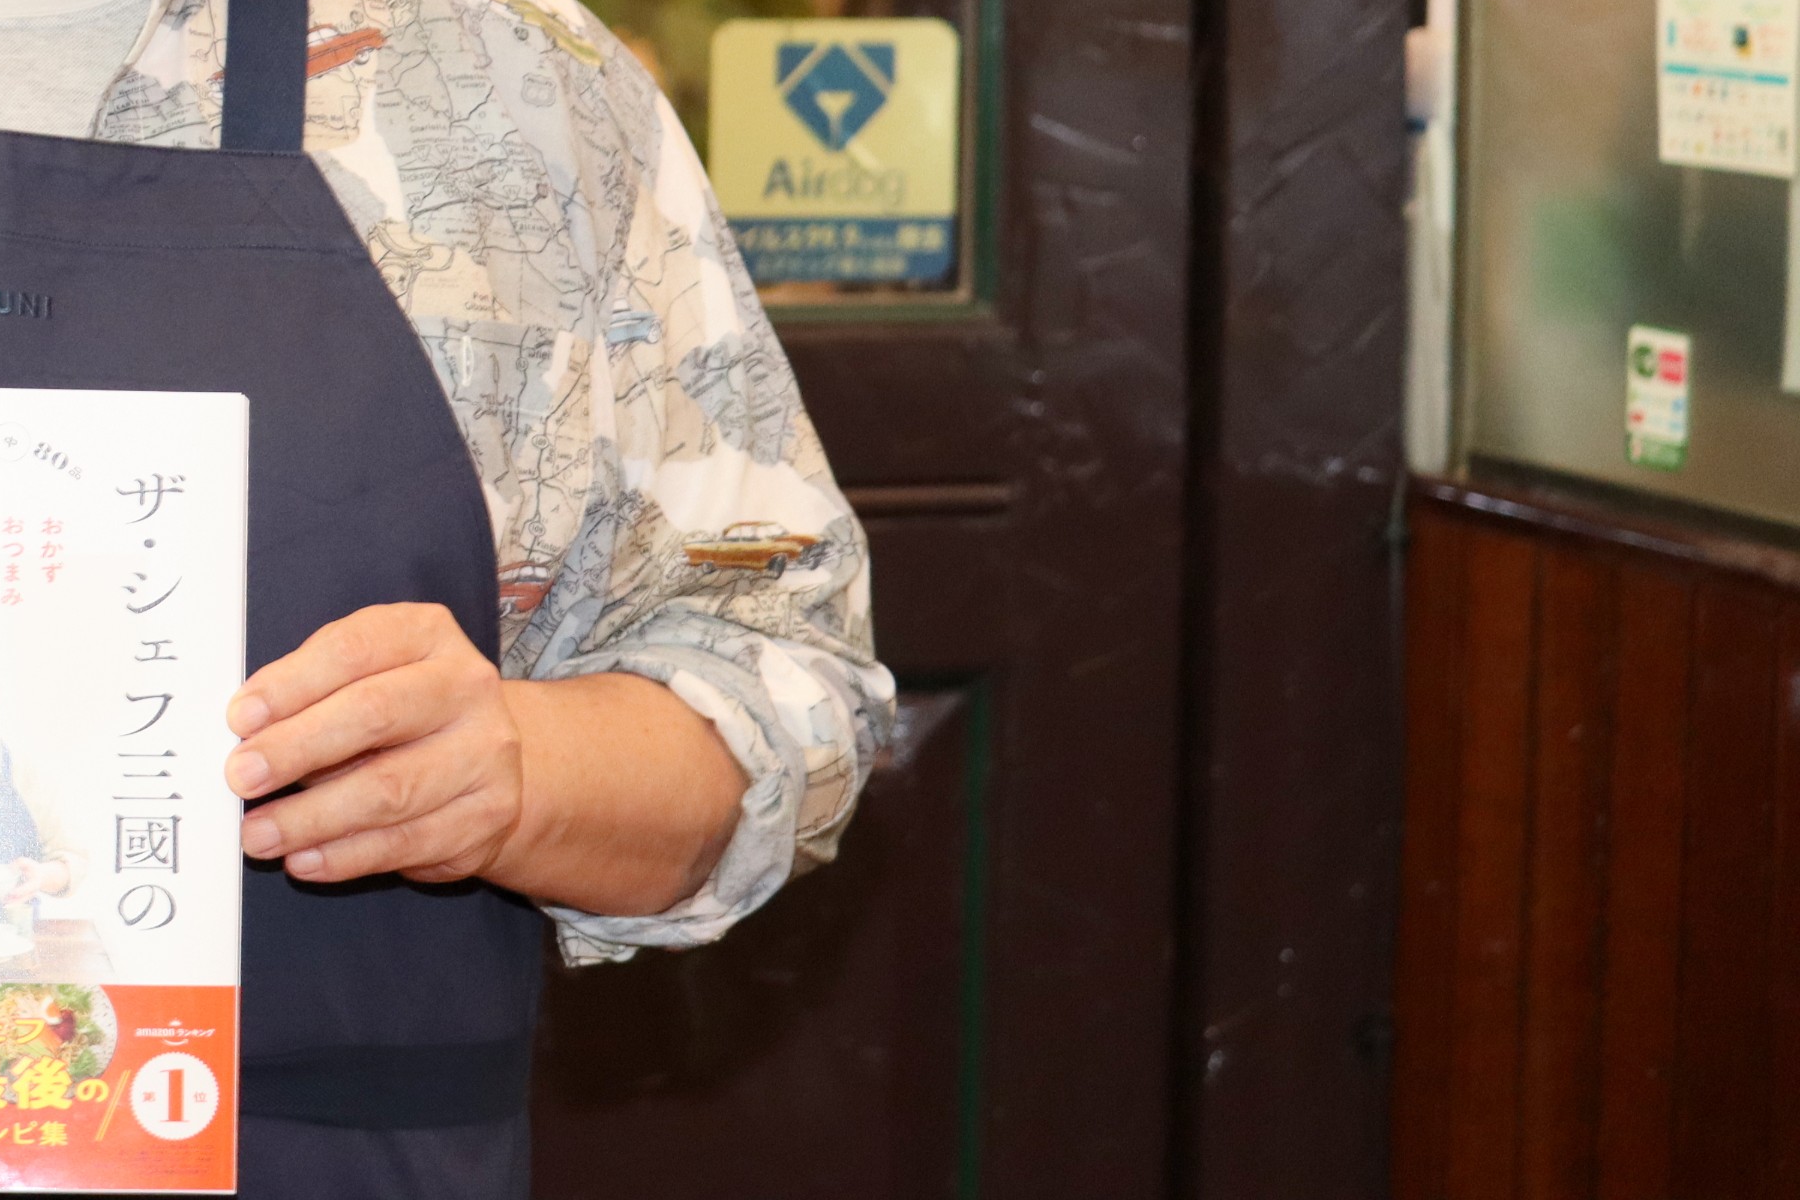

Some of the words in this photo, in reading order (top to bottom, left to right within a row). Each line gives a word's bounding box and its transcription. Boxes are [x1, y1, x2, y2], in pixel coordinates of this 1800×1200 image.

[1, 516, 26, 607] おつまみ
[40, 516, 65, 585] おかず
[111, 472, 187, 933] ザ・シェフ三國の
[134, 1026, 175, 1038] amazon
[175, 1027, 216, 1038] ランキング
